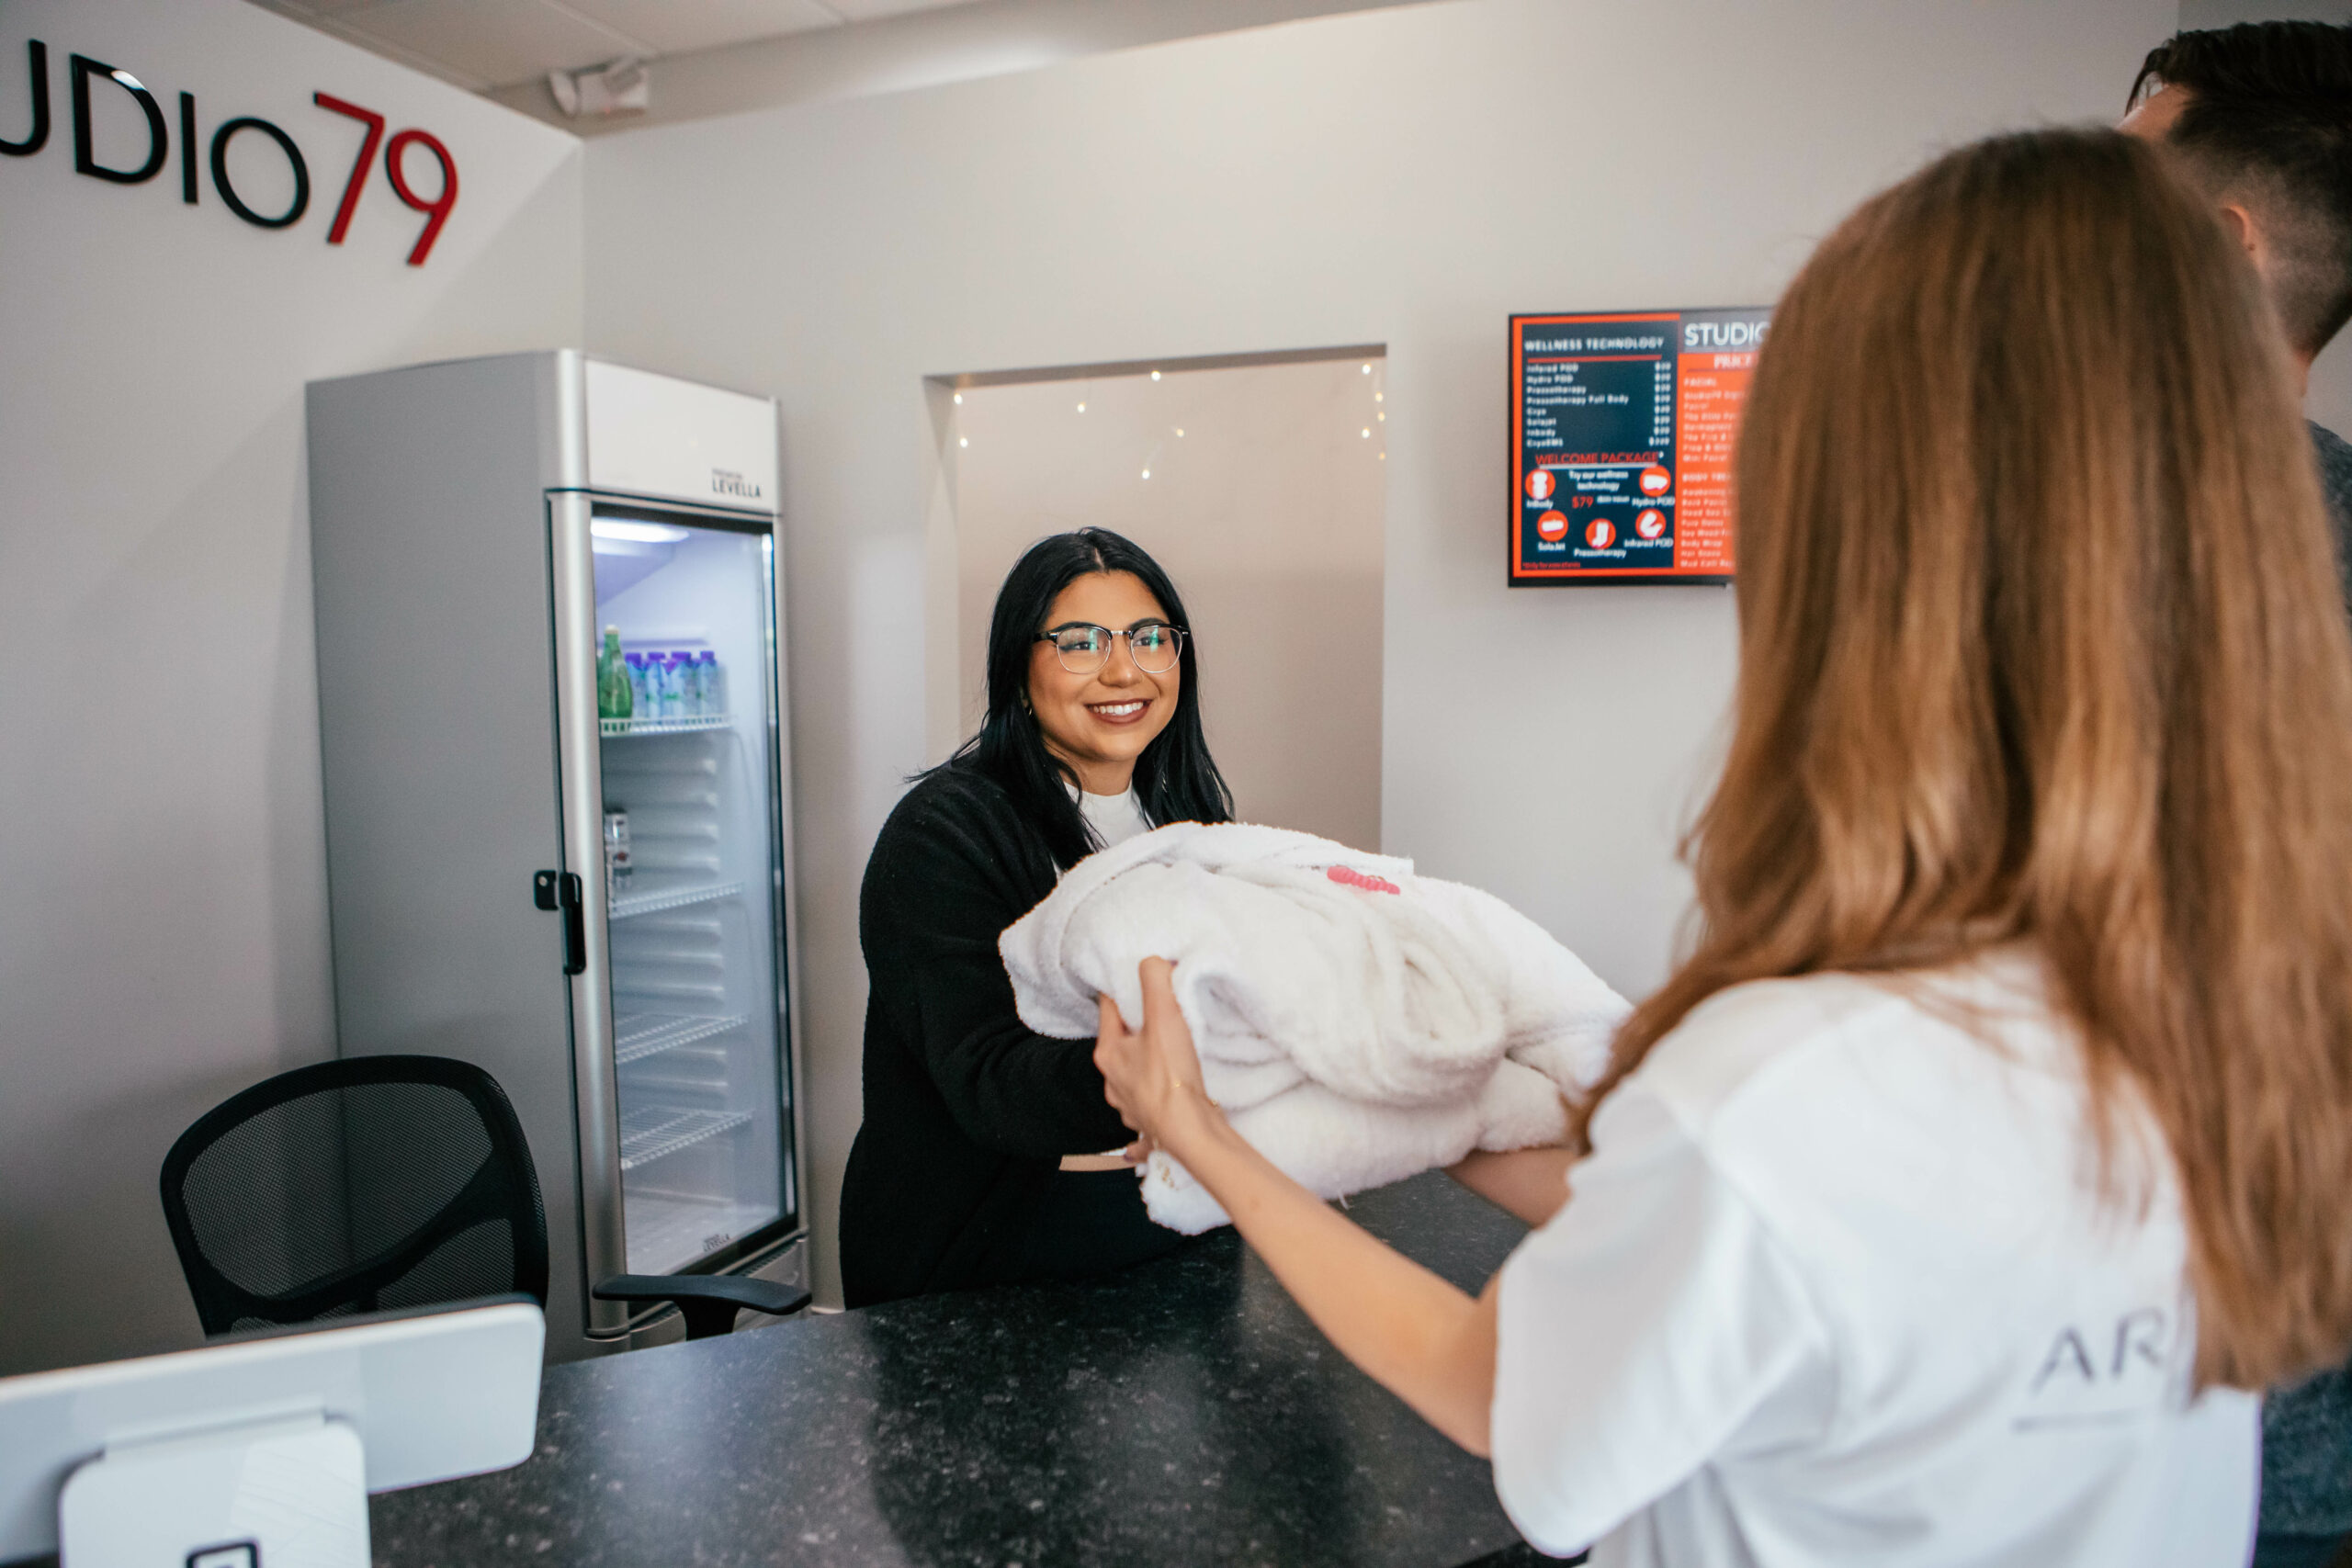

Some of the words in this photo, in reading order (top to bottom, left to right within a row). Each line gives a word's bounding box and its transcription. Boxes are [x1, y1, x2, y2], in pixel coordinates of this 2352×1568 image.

[1525, 338, 1582, 351] WELLNESS
[1586, 336, 1664, 350] TECHNOLOGY
[1560, 362, 1578, 373] POD
[1527, 375, 1552, 385] Hydro
[1555, 374, 1573, 383] POD
[1527, 386, 1586, 395] Pressotherapy
[1527, 396, 1586, 406] Pressotherapy
[1588, 394, 1606, 403] Full
[1607, 394, 1629, 405] Body
[1535, 454, 1598, 465] WELCOME
[1569, 470, 1580, 481] Try
[1597, 470, 1628, 479] wellness
[712, 478, 761, 498] LEVELLA
[1577, 481, 1620, 491] technology
[1572, 496, 1594, 508] $79
[1632, 498, 1657, 508] Hydro
[1656, 538, 1674, 547] POD
[1574, 548, 1626, 558] Pressotherapy
